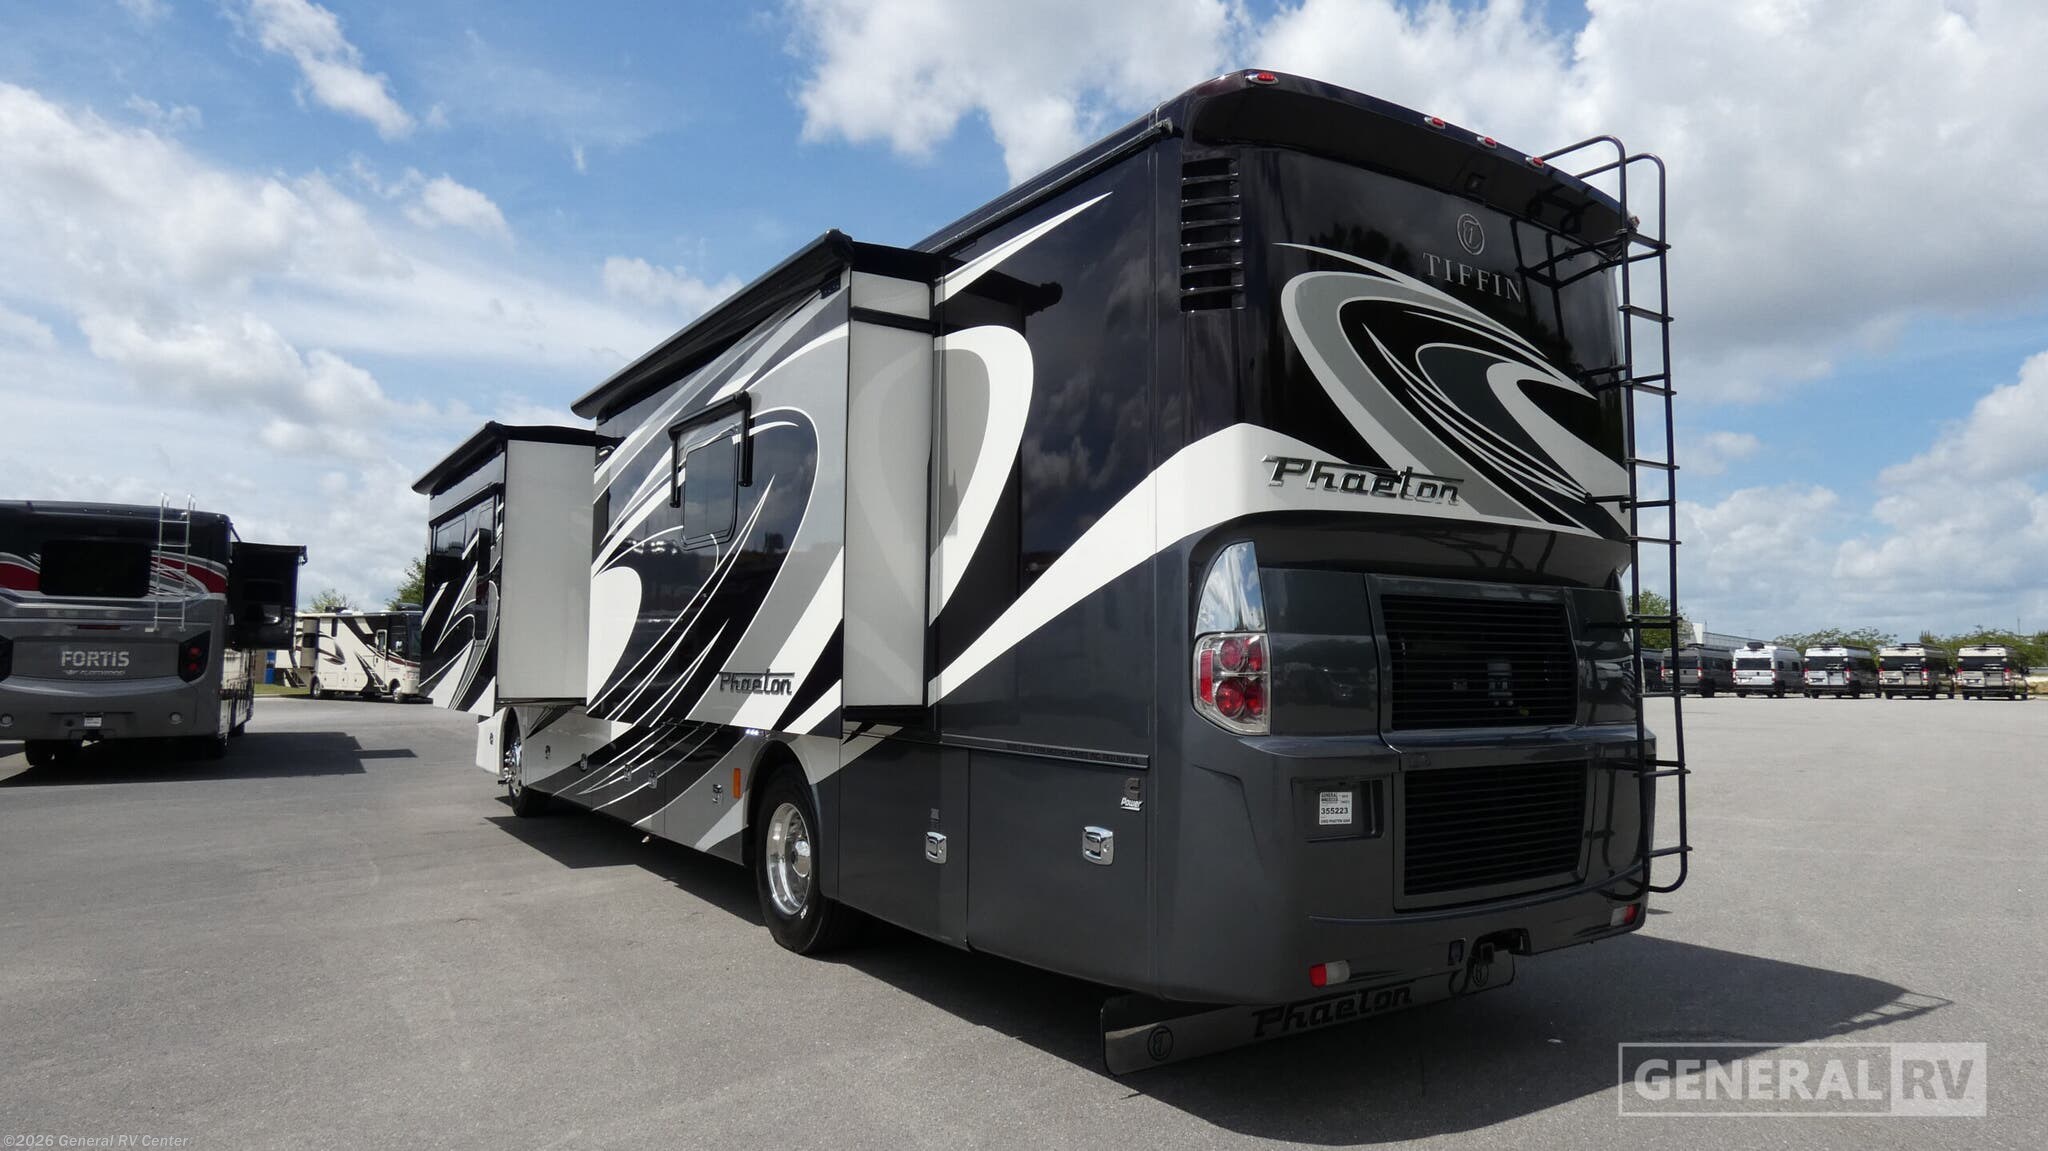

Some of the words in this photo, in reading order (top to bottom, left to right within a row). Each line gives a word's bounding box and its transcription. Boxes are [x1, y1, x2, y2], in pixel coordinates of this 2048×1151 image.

[1422, 252, 1521, 303] TIFFIN
[1261, 454, 1464, 506] Phaeton
[61, 651, 130, 667] FORTIS
[719, 668, 795, 695] Phaeton
[1121, 797, 1144, 809] Power
[1321, 807, 1349, 815] 355223
[1253, 979, 1416, 1037] Phaeton
